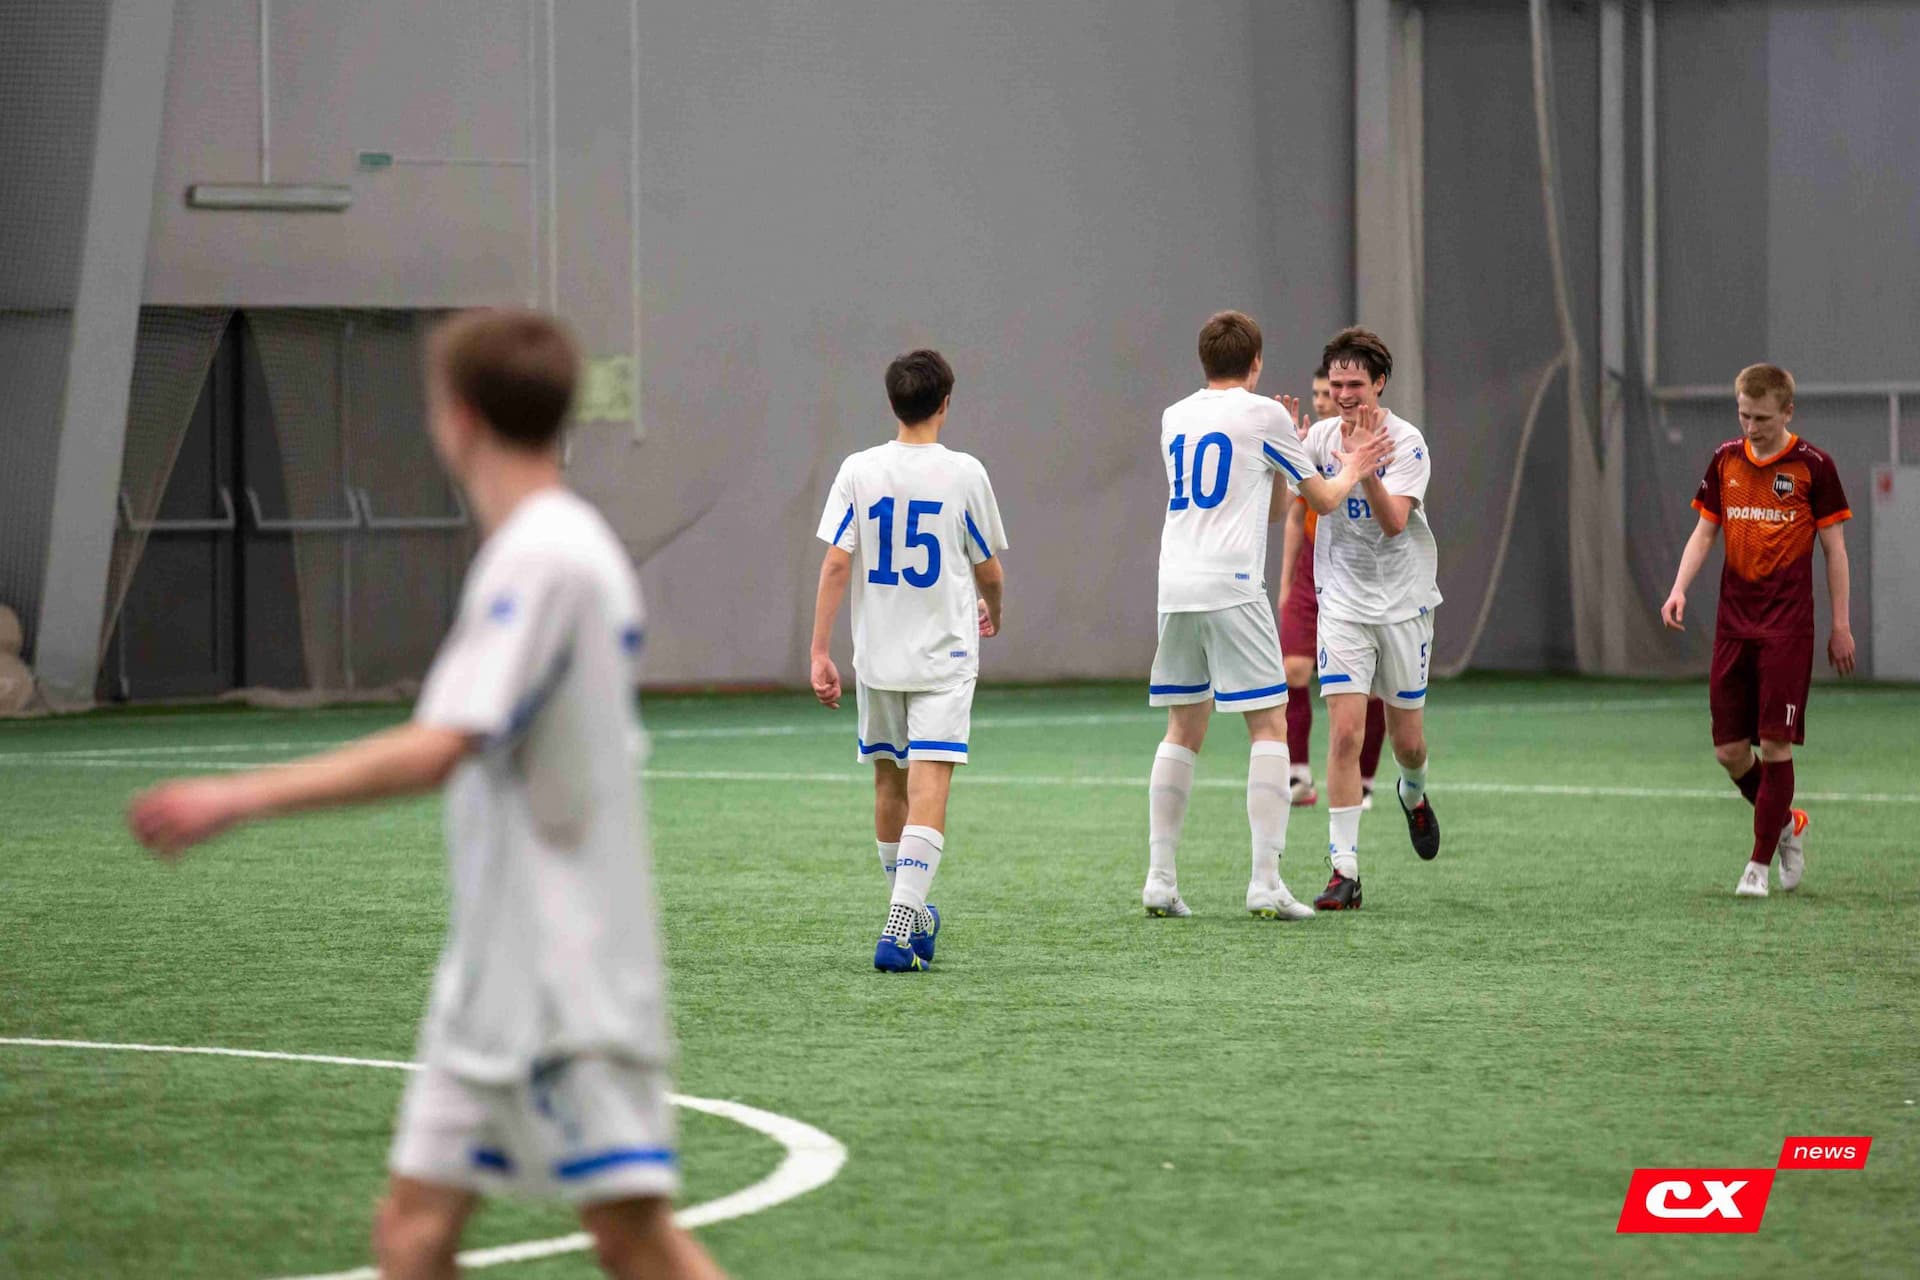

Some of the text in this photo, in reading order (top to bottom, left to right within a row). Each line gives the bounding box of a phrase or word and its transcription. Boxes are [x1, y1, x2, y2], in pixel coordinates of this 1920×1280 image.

[1169, 432, 1233, 511] 10
[868, 496, 944, 589] 15
[1420, 642, 1428, 669] 5
[1785, 703, 1796, 727] 17
